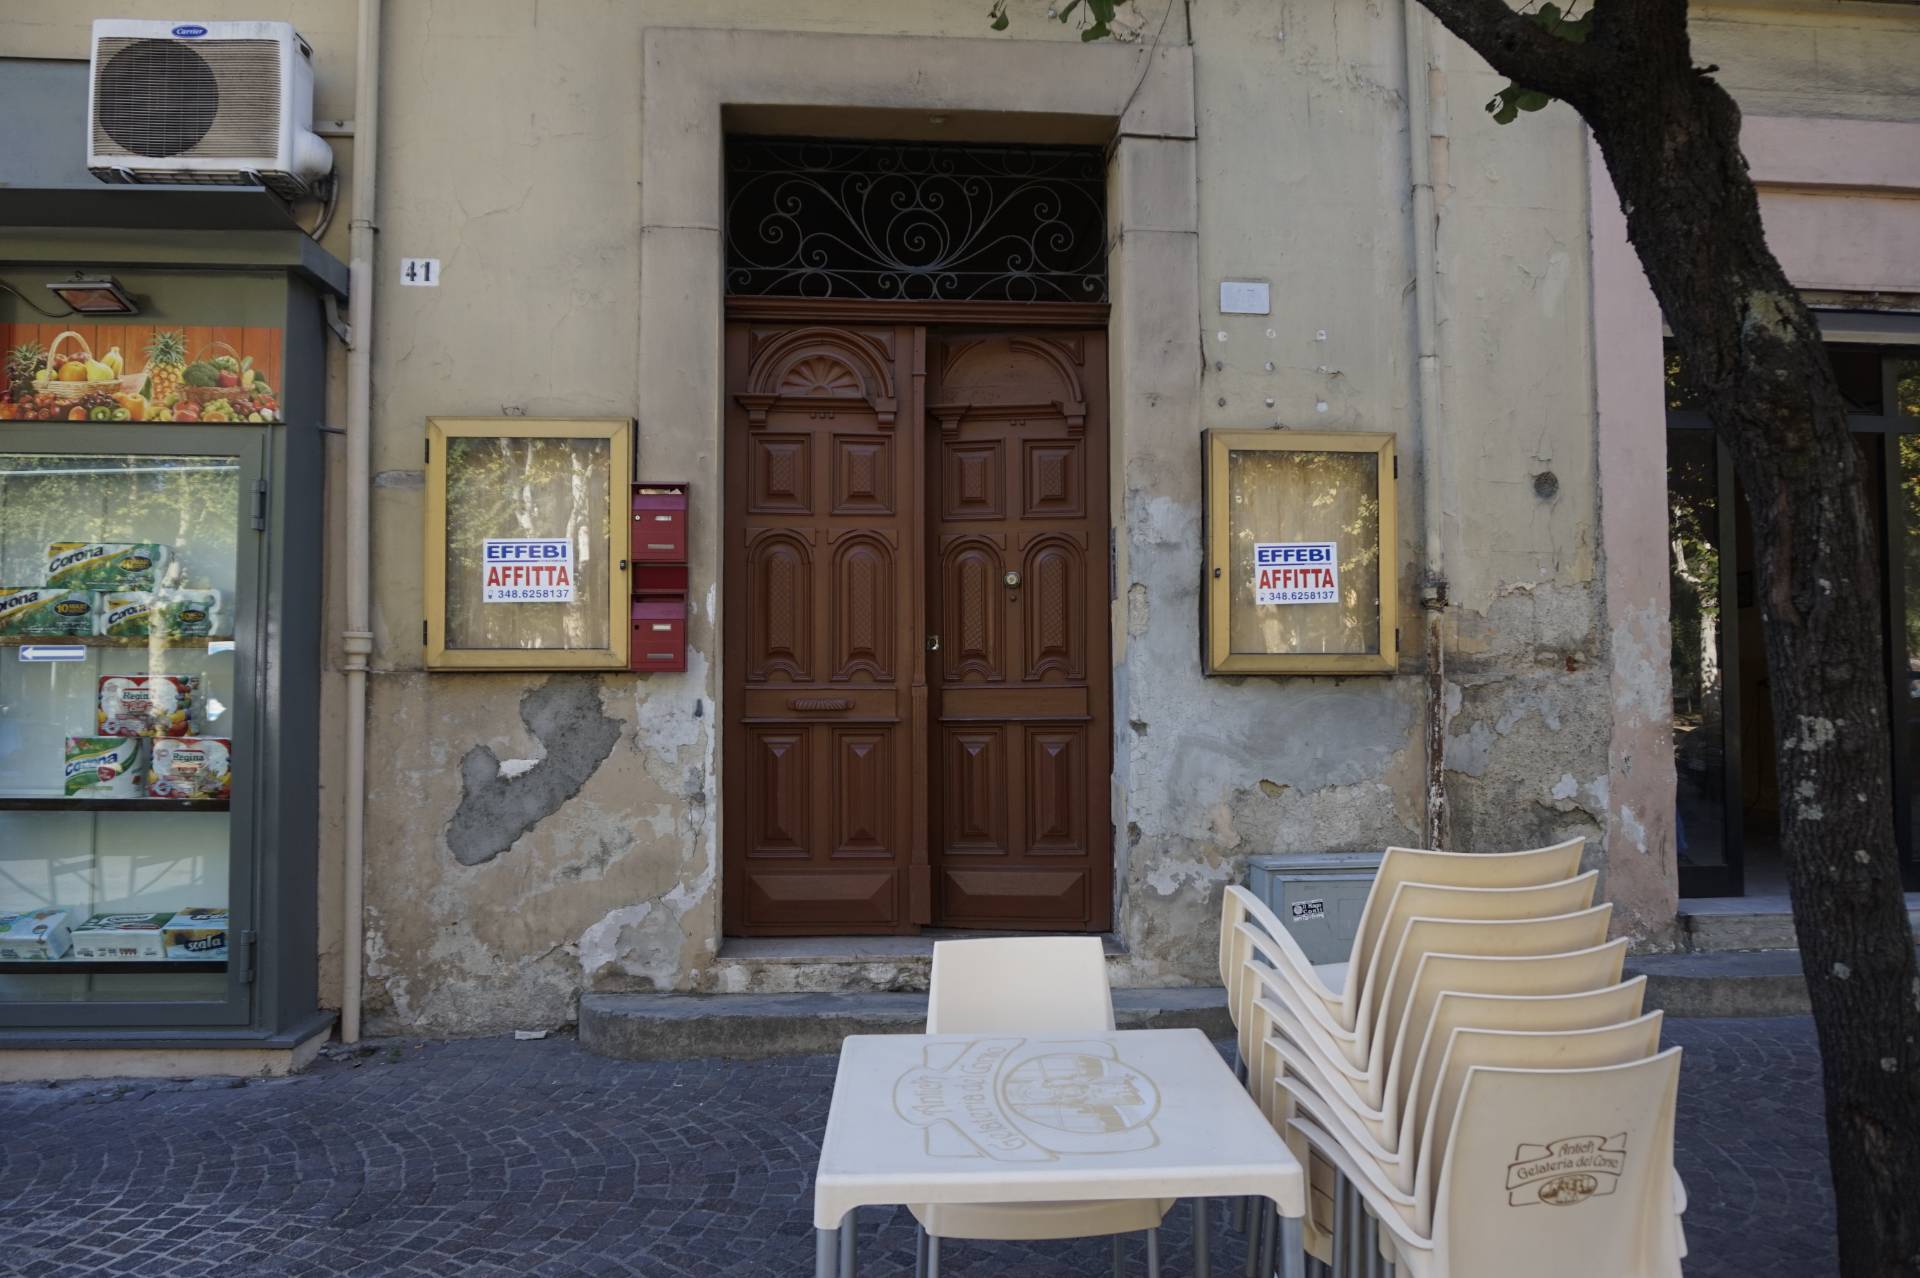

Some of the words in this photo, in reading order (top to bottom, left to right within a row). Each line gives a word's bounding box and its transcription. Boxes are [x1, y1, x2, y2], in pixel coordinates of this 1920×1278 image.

[405, 261, 431, 282] 41
[487, 545, 567, 559] EFFEBI
[1258, 549, 1331, 562] EFFEBI
[49, 546, 104, 573] Corona
[487, 566, 570, 587] AFFITTA
[1259, 568, 1335, 589] AFFITTA
[498, 589, 570, 599] 348.6258137
[1269, 591, 1335, 600] 348.6258137
[122, 692, 154, 701] Regin
[173, 752, 205, 762] Regina
[188, 935, 222, 950] scala
[1517, 1159, 1574, 1180] Gelateria
[1575, 1156, 1592, 1169] del
